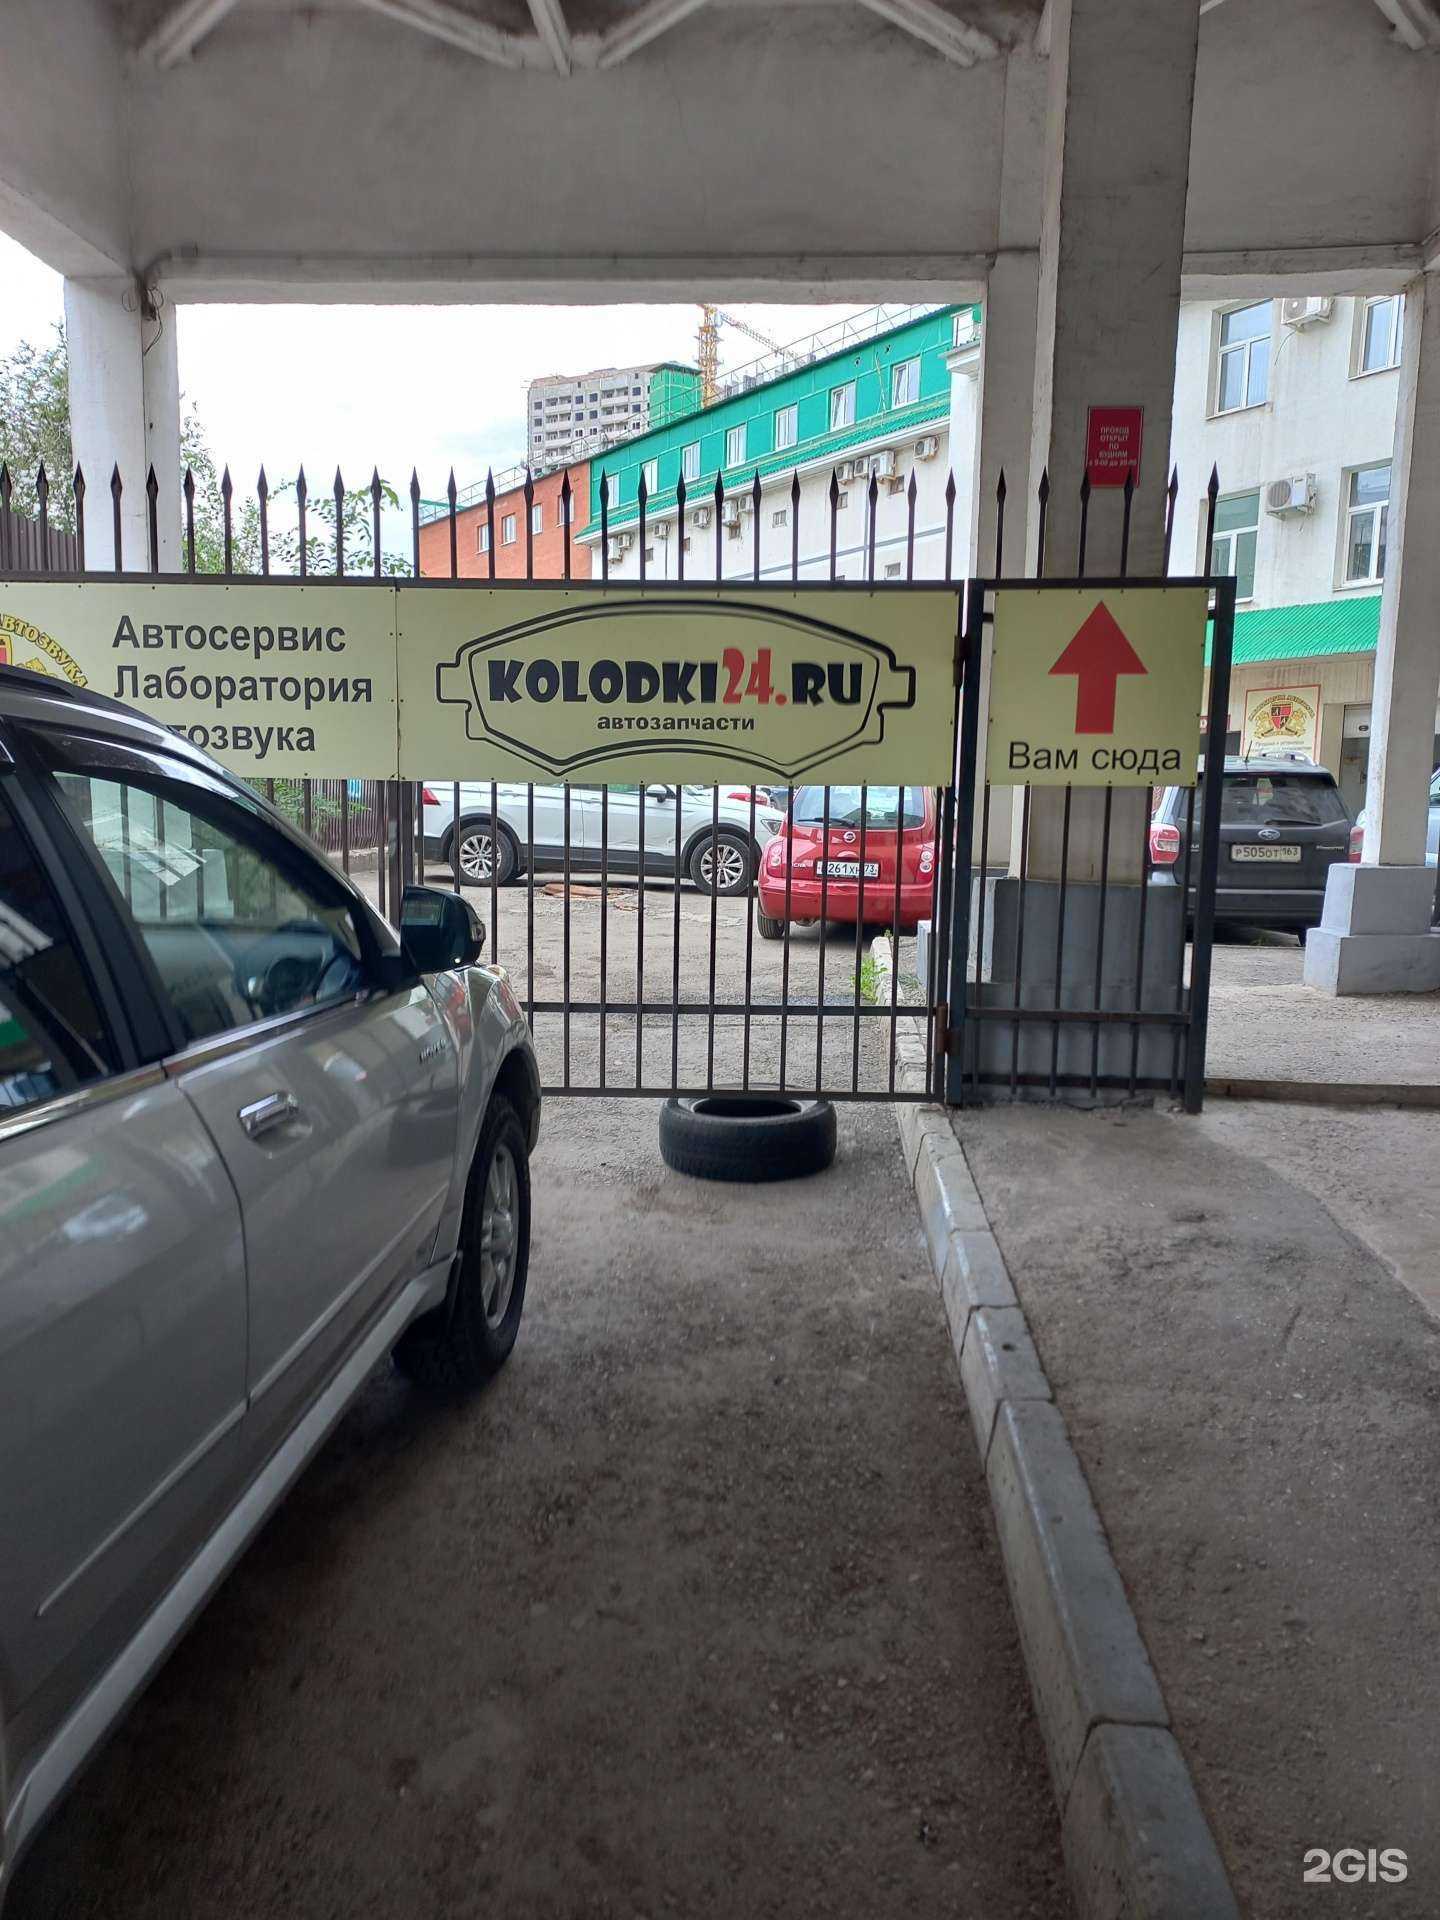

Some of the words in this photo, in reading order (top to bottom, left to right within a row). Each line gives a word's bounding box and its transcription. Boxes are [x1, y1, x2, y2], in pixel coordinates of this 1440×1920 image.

[0, 613, 88, 687] ВТОЗВУКА
[112, 615, 346, 659] Автосервис
[114, 665, 373, 709] Лаборатория
[487, 647, 863, 706] KOLODKI24.RU
[597, 714, 755, 731] автозапчасти
[1008, 741, 1078, 770] Вам
[1092, 744, 1181, 774] сюда
